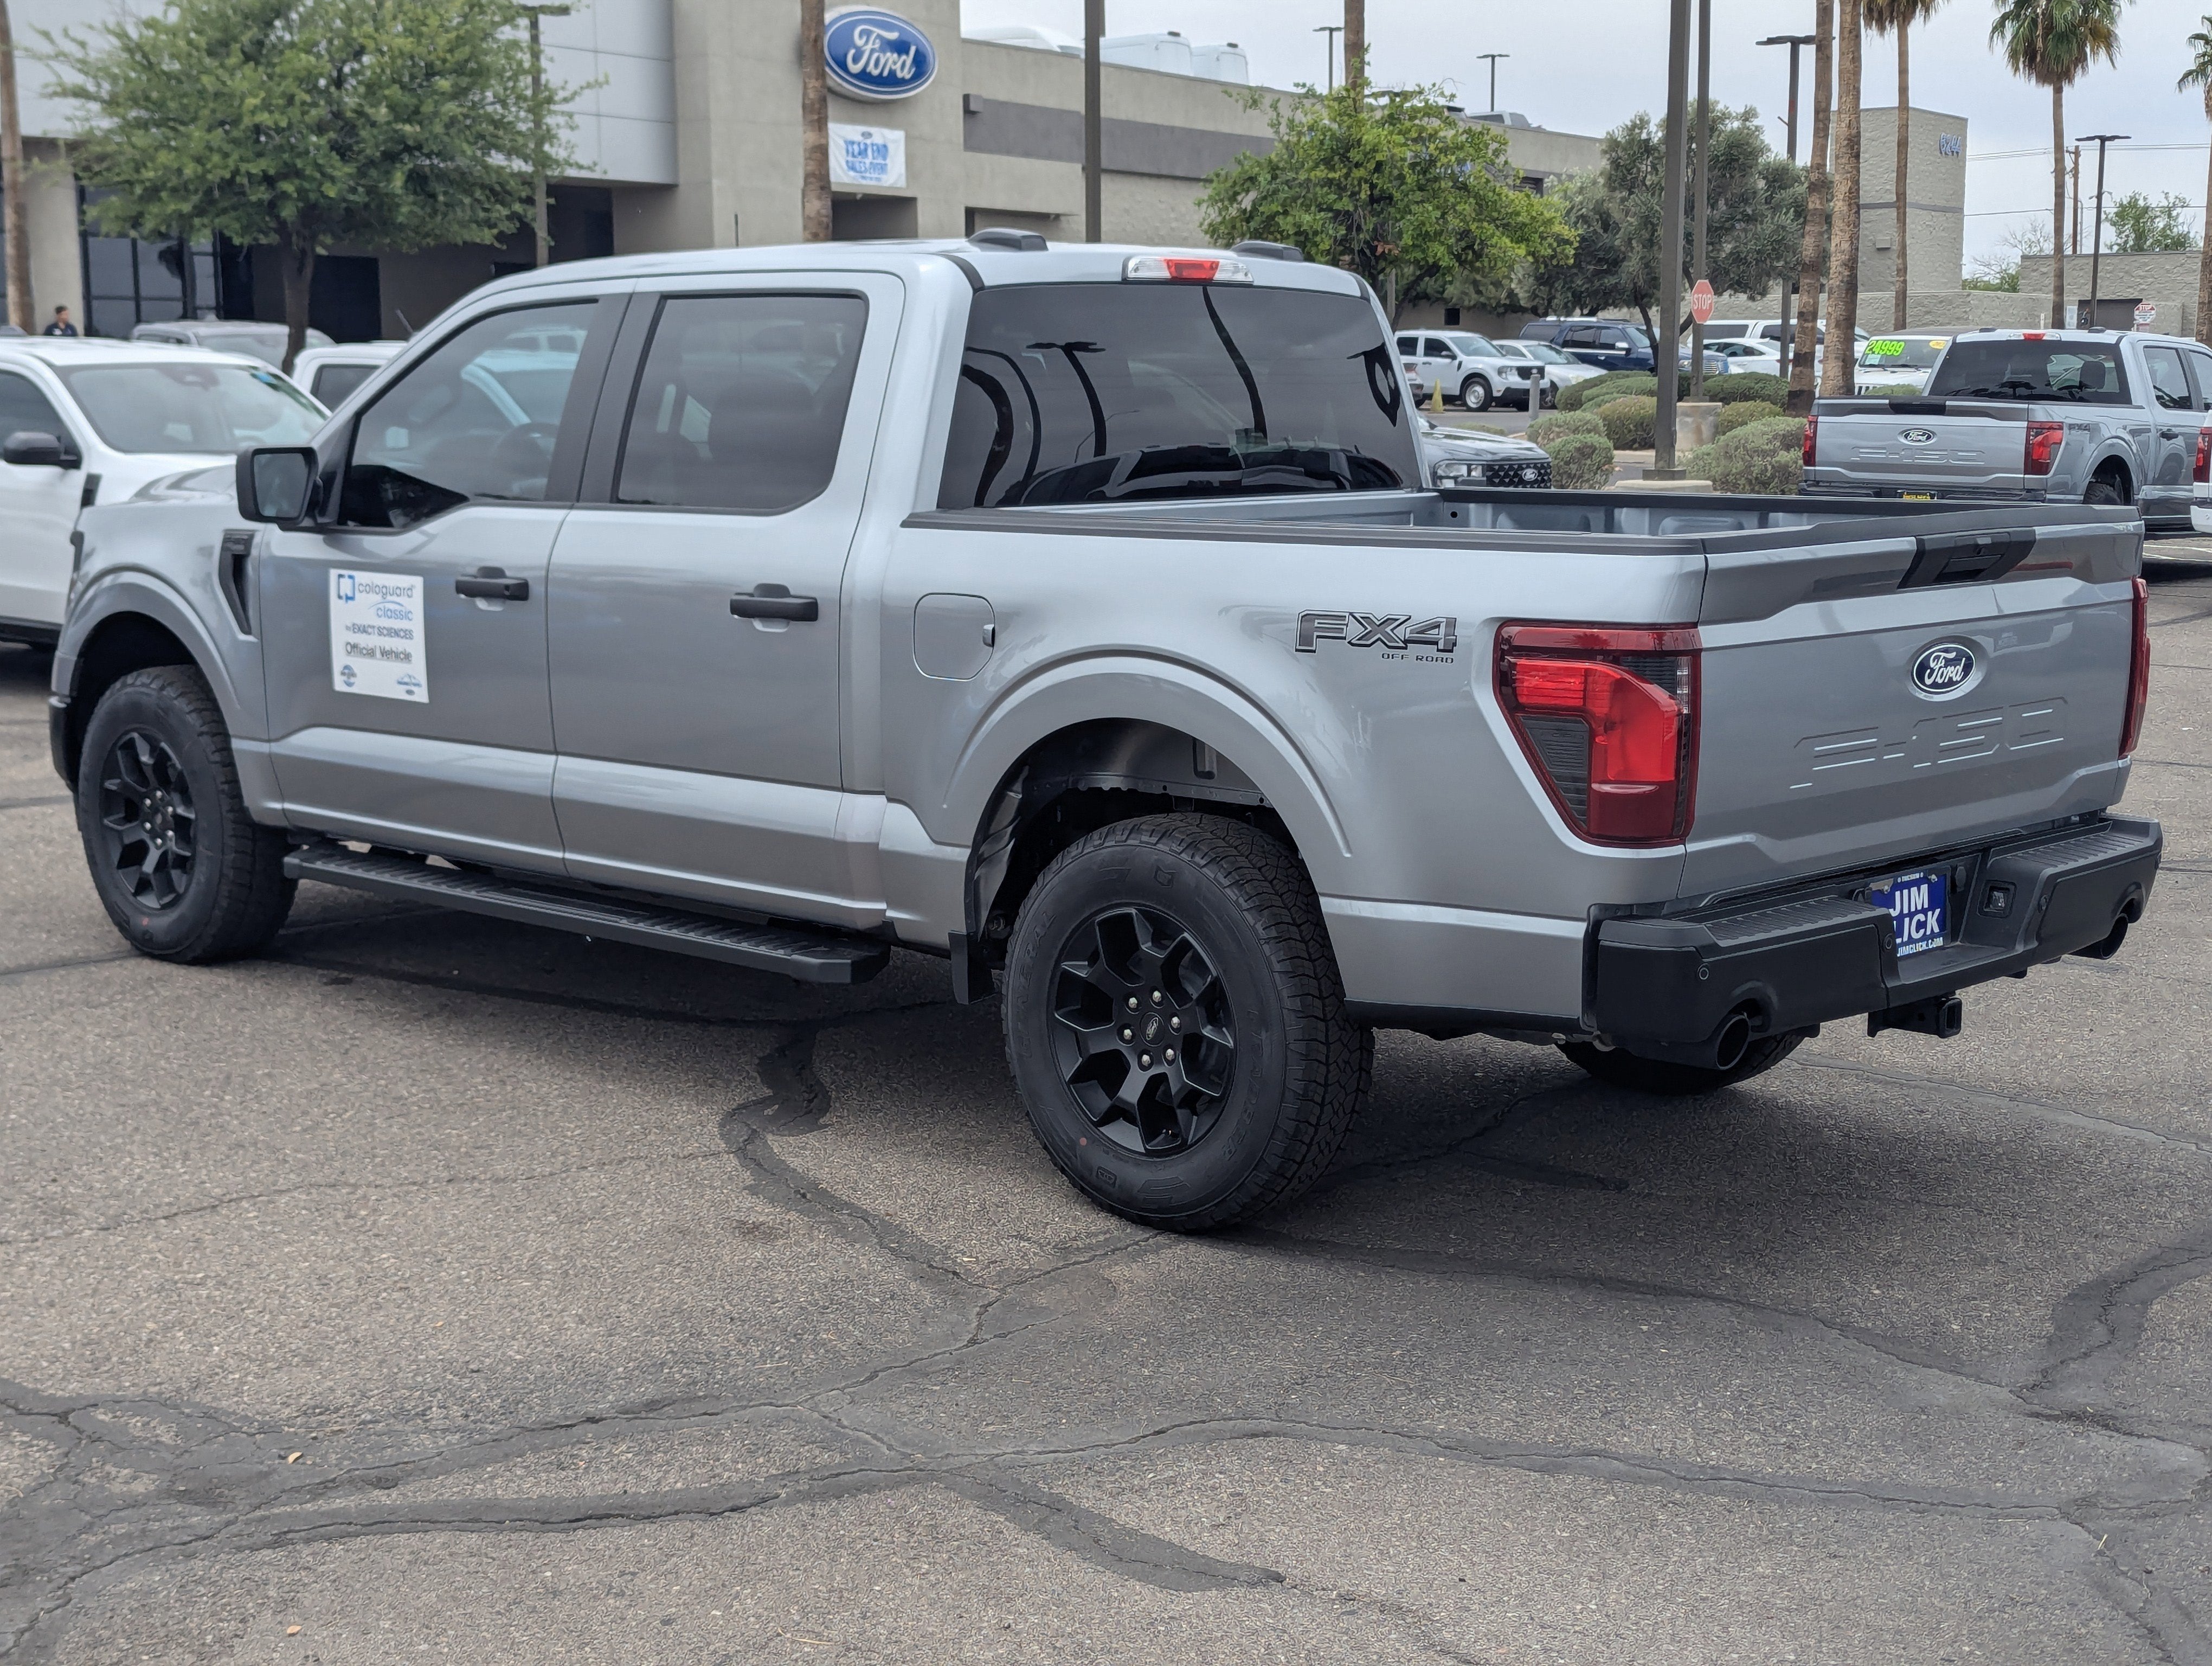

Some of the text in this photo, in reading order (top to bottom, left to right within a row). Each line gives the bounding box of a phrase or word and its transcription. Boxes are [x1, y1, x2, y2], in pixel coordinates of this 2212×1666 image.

[846, 25, 916, 79] Ford
[1694, 294, 1712, 310] STOP
[1864, 341, 1905, 356] 24999
[358, 582, 414, 599] cologuard
[376, 606, 413, 621] classic
[352, 623, 376, 635] EXACT
[377, 626, 414, 640] SCIENCES
[1295, 609, 1457, 653] FX4
[345, 642, 412, 661] Official Vehicle
[1381, 652, 1454, 664] OFF ROAD
[1925, 652, 1965, 684] Ford
[1790, 697, 2068, 789] F-150
[1889, 884, 1928, 917] JIM
